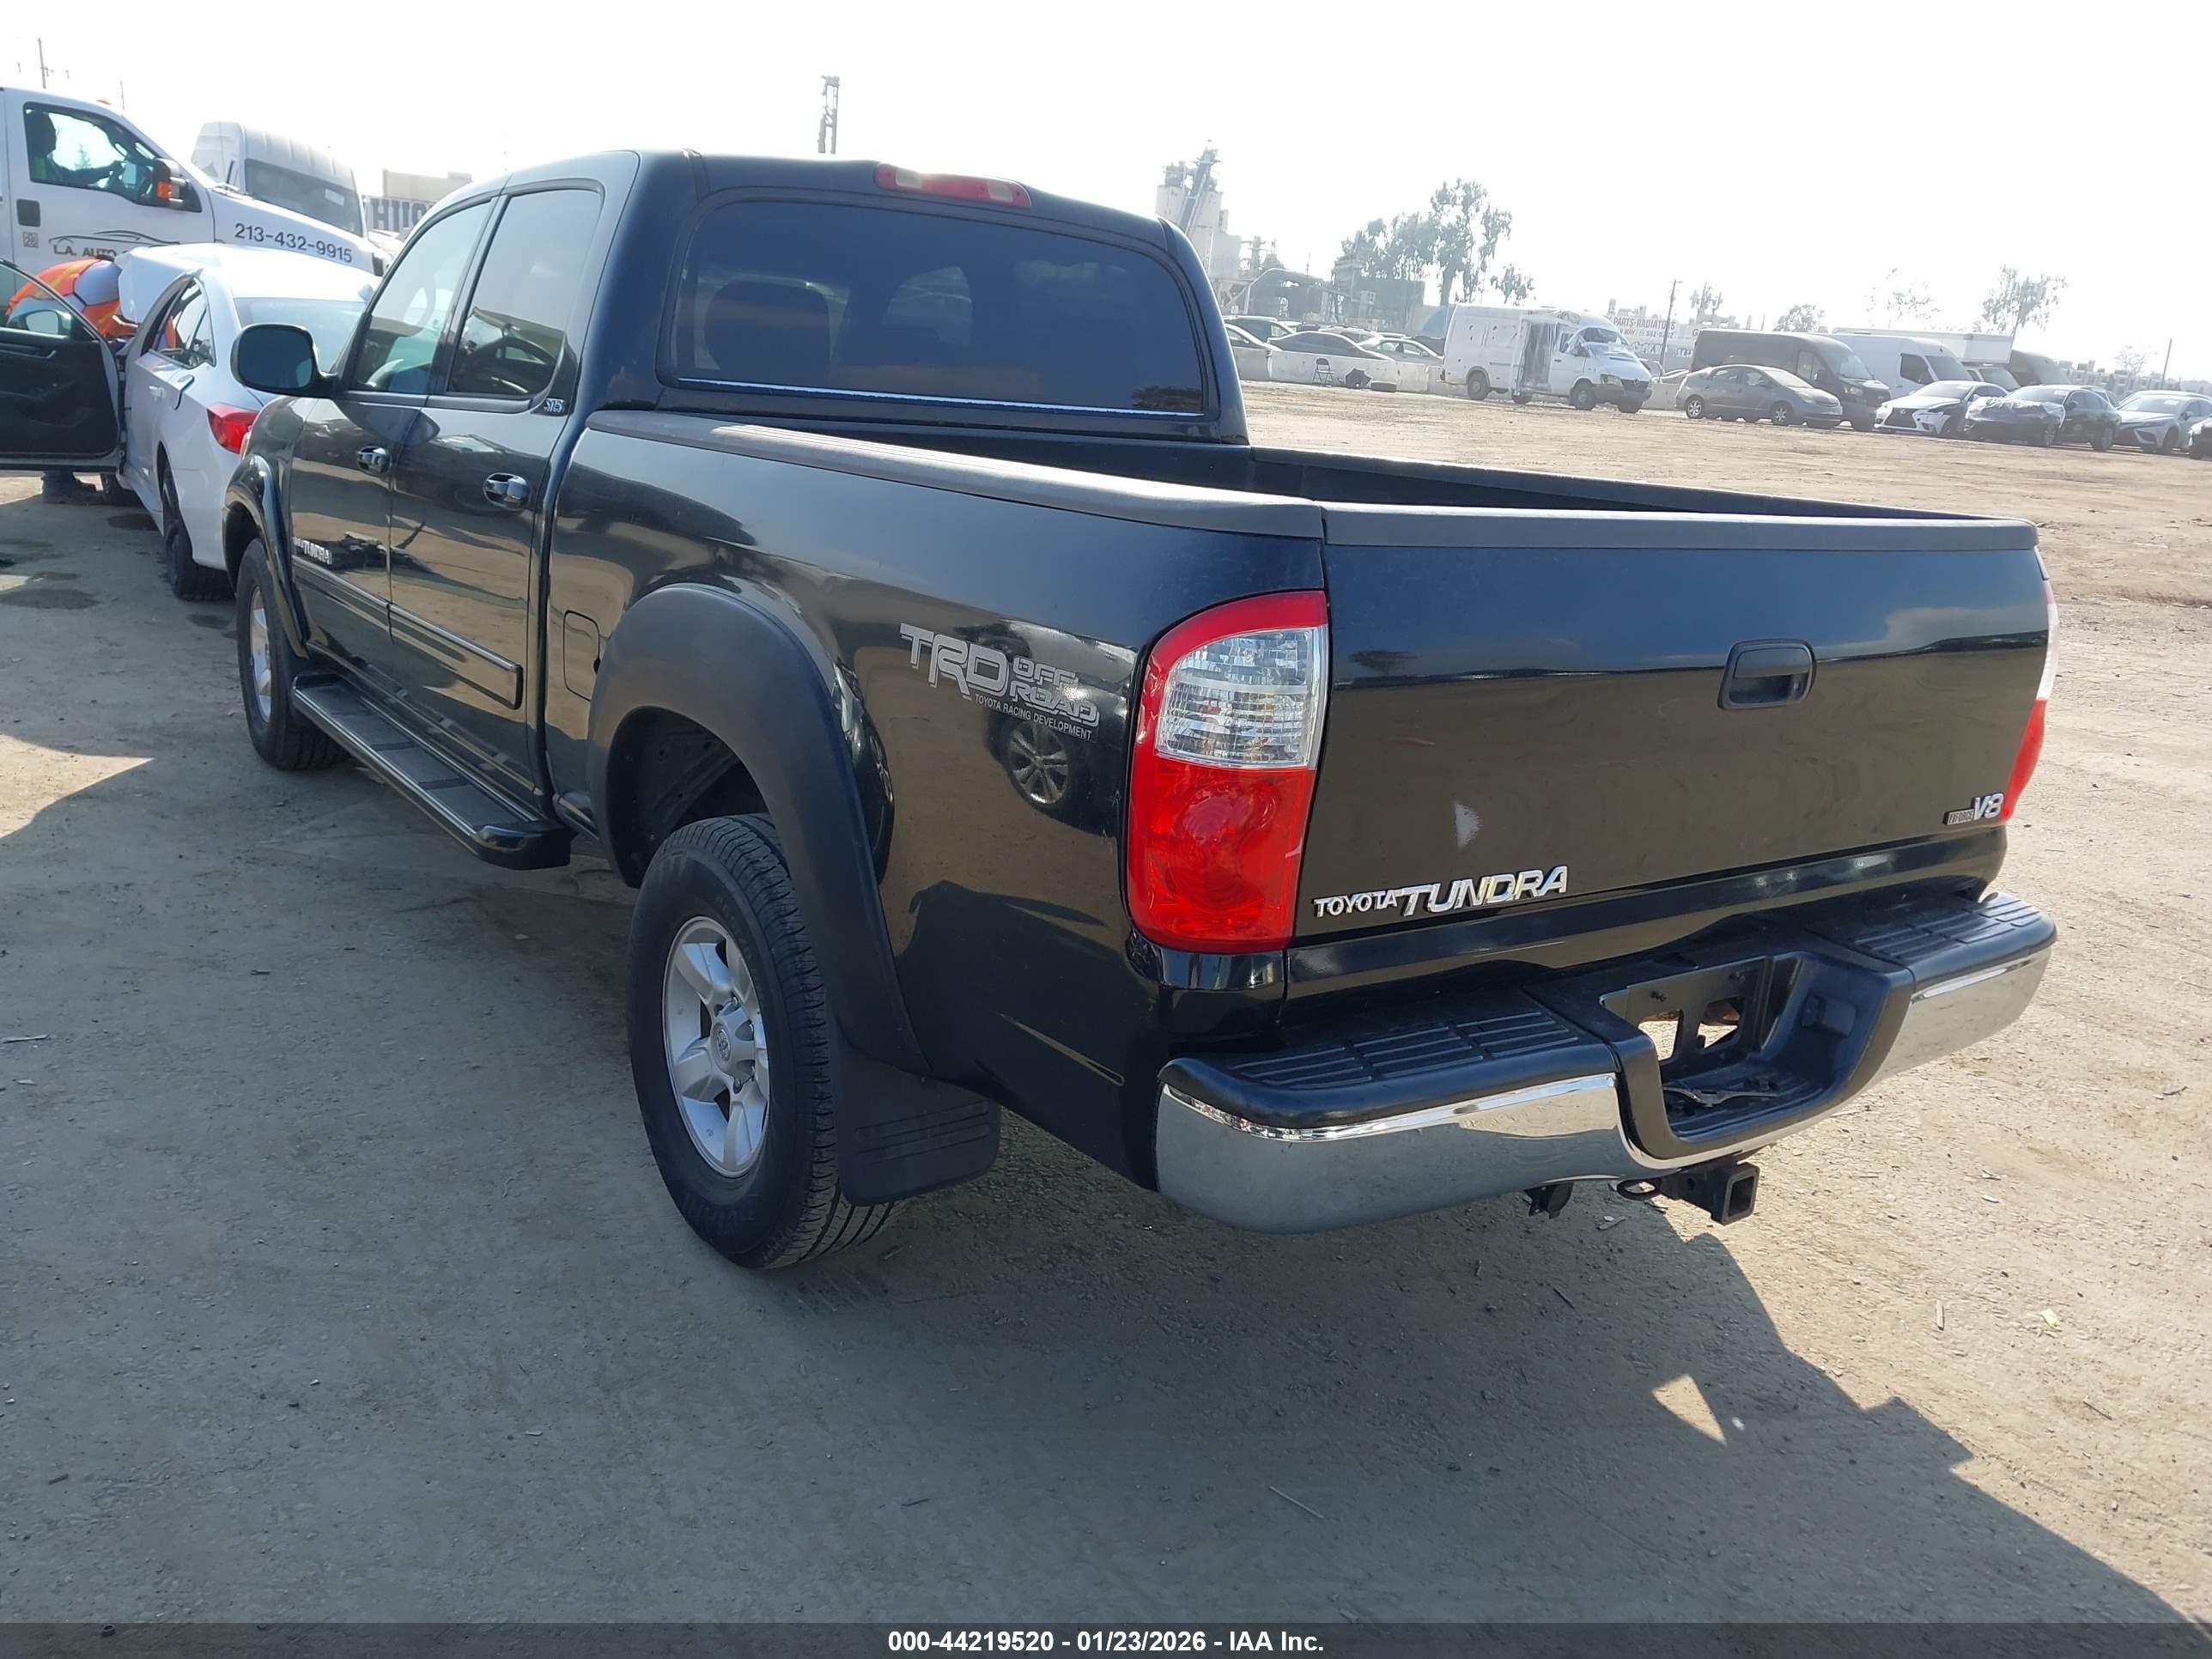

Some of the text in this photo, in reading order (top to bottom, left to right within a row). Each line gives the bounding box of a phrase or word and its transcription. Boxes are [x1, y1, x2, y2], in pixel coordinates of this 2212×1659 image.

[53, 245, 76, 256] L.A.
[234, 222, 353, 263] 213-432-9915
[899, 623, 1079, 701] TRD OFF
[975, 694, 1093, 741] TOYOTA RACING DEVELOPMENT
[1009, 681, 1099, 727] ROAD
[1972, 792, 2004, 821] V8
[1314, 865, 1568, 918] TOYOTA TUNDRA
